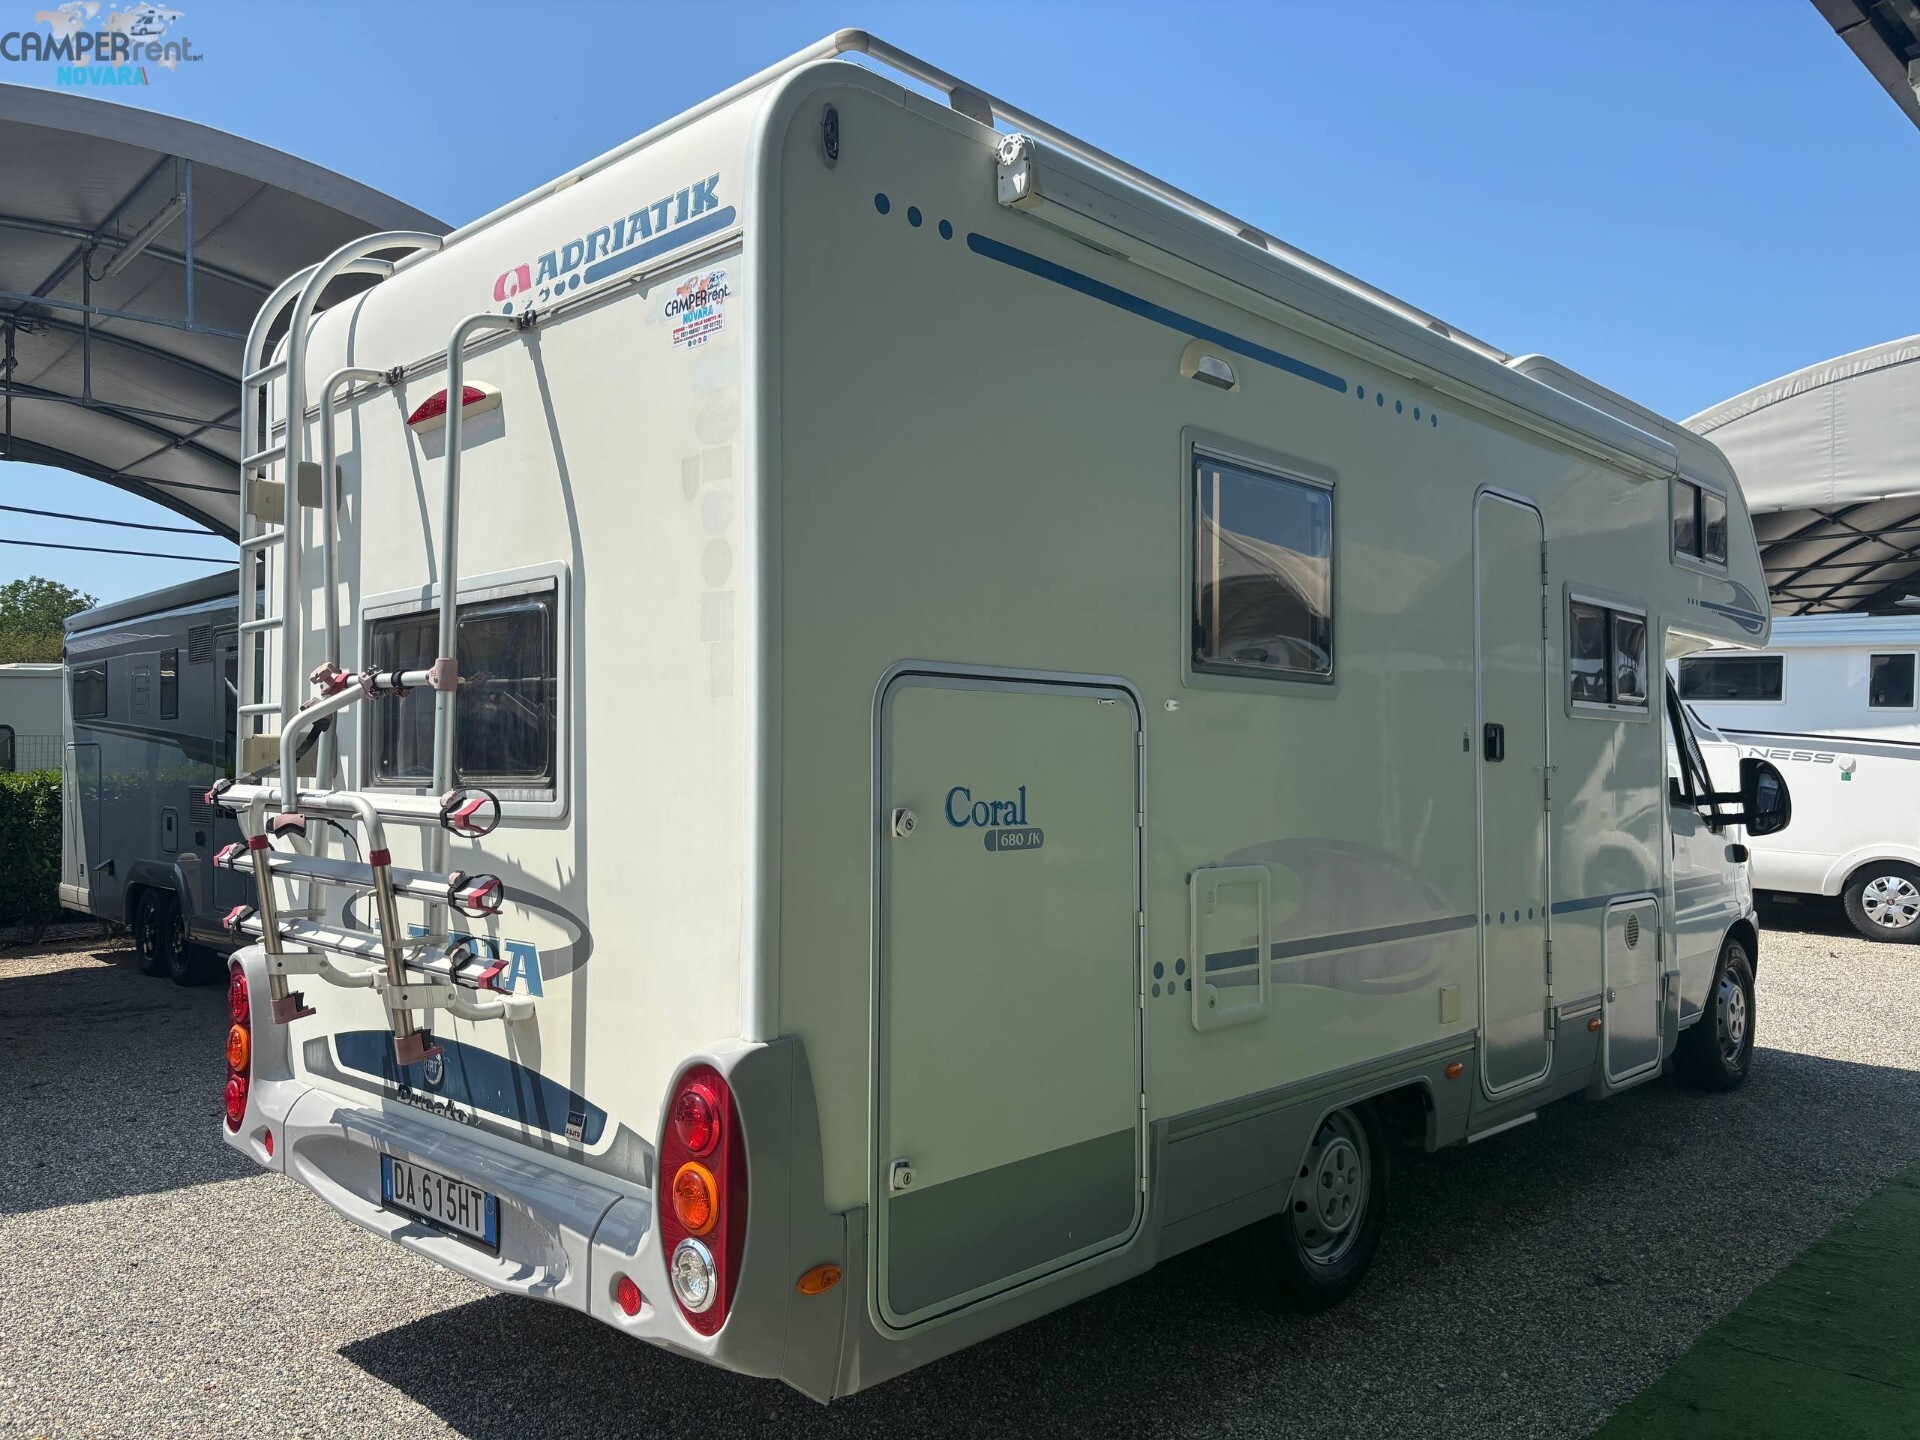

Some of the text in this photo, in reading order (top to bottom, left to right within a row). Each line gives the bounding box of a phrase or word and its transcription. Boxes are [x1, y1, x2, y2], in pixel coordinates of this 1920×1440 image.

[536, 172, 719, 286] ADRIATIK
[682, 305, 714, 325] NOVARA
[1748, 747, 1836, 764] NESS
[945, 784, 1028, 828] Coral
[1000, 833, 1024, 847] 680
[396, 1083, 471, 1125] Ducato
[394, 1162, 416, 1206] DA
[421, 1173, 482, 1232] 615HT
